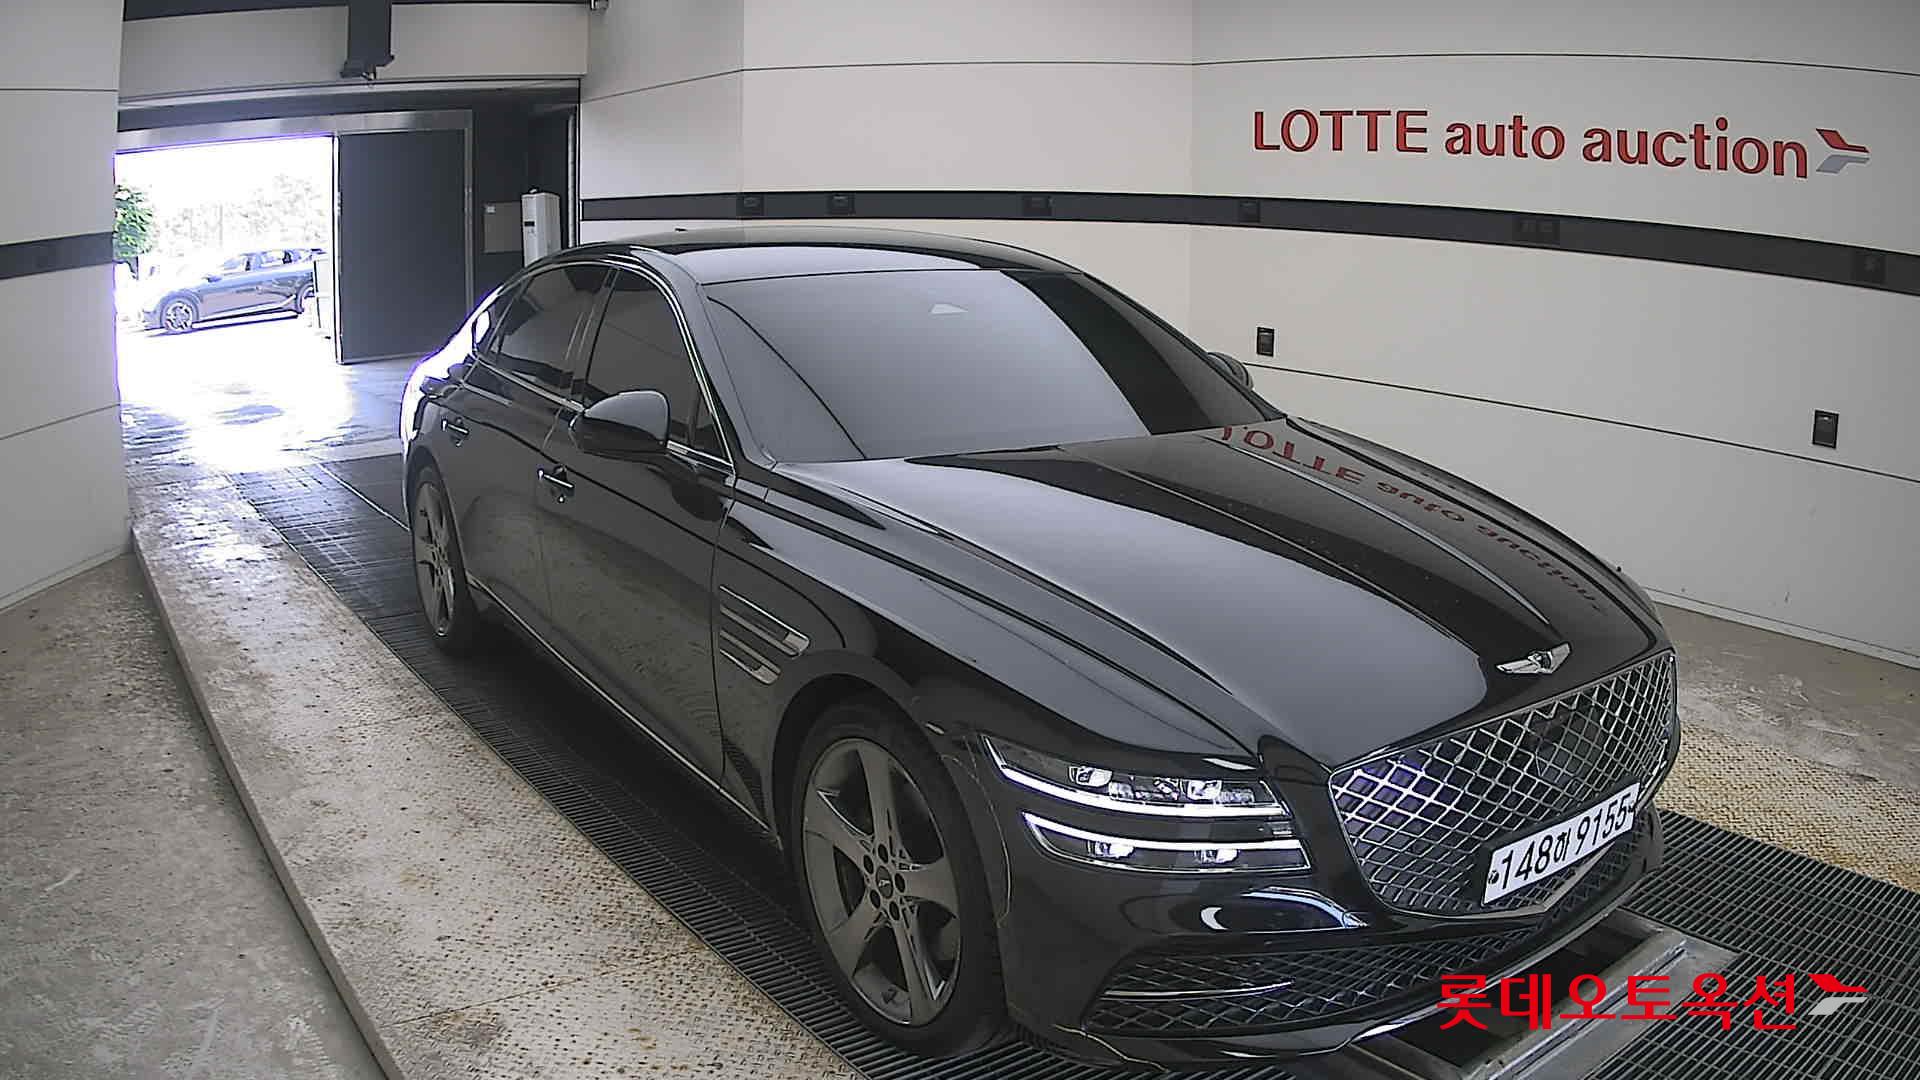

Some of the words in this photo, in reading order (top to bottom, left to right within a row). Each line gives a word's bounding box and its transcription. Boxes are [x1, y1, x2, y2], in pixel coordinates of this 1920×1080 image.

[1253, 109, 1427, 153] LOTTE
[1445, 115, 1566, 159] auto
[1582, 117, 1807, 178] auction
[1575, 793, 1631, 855] 9155
